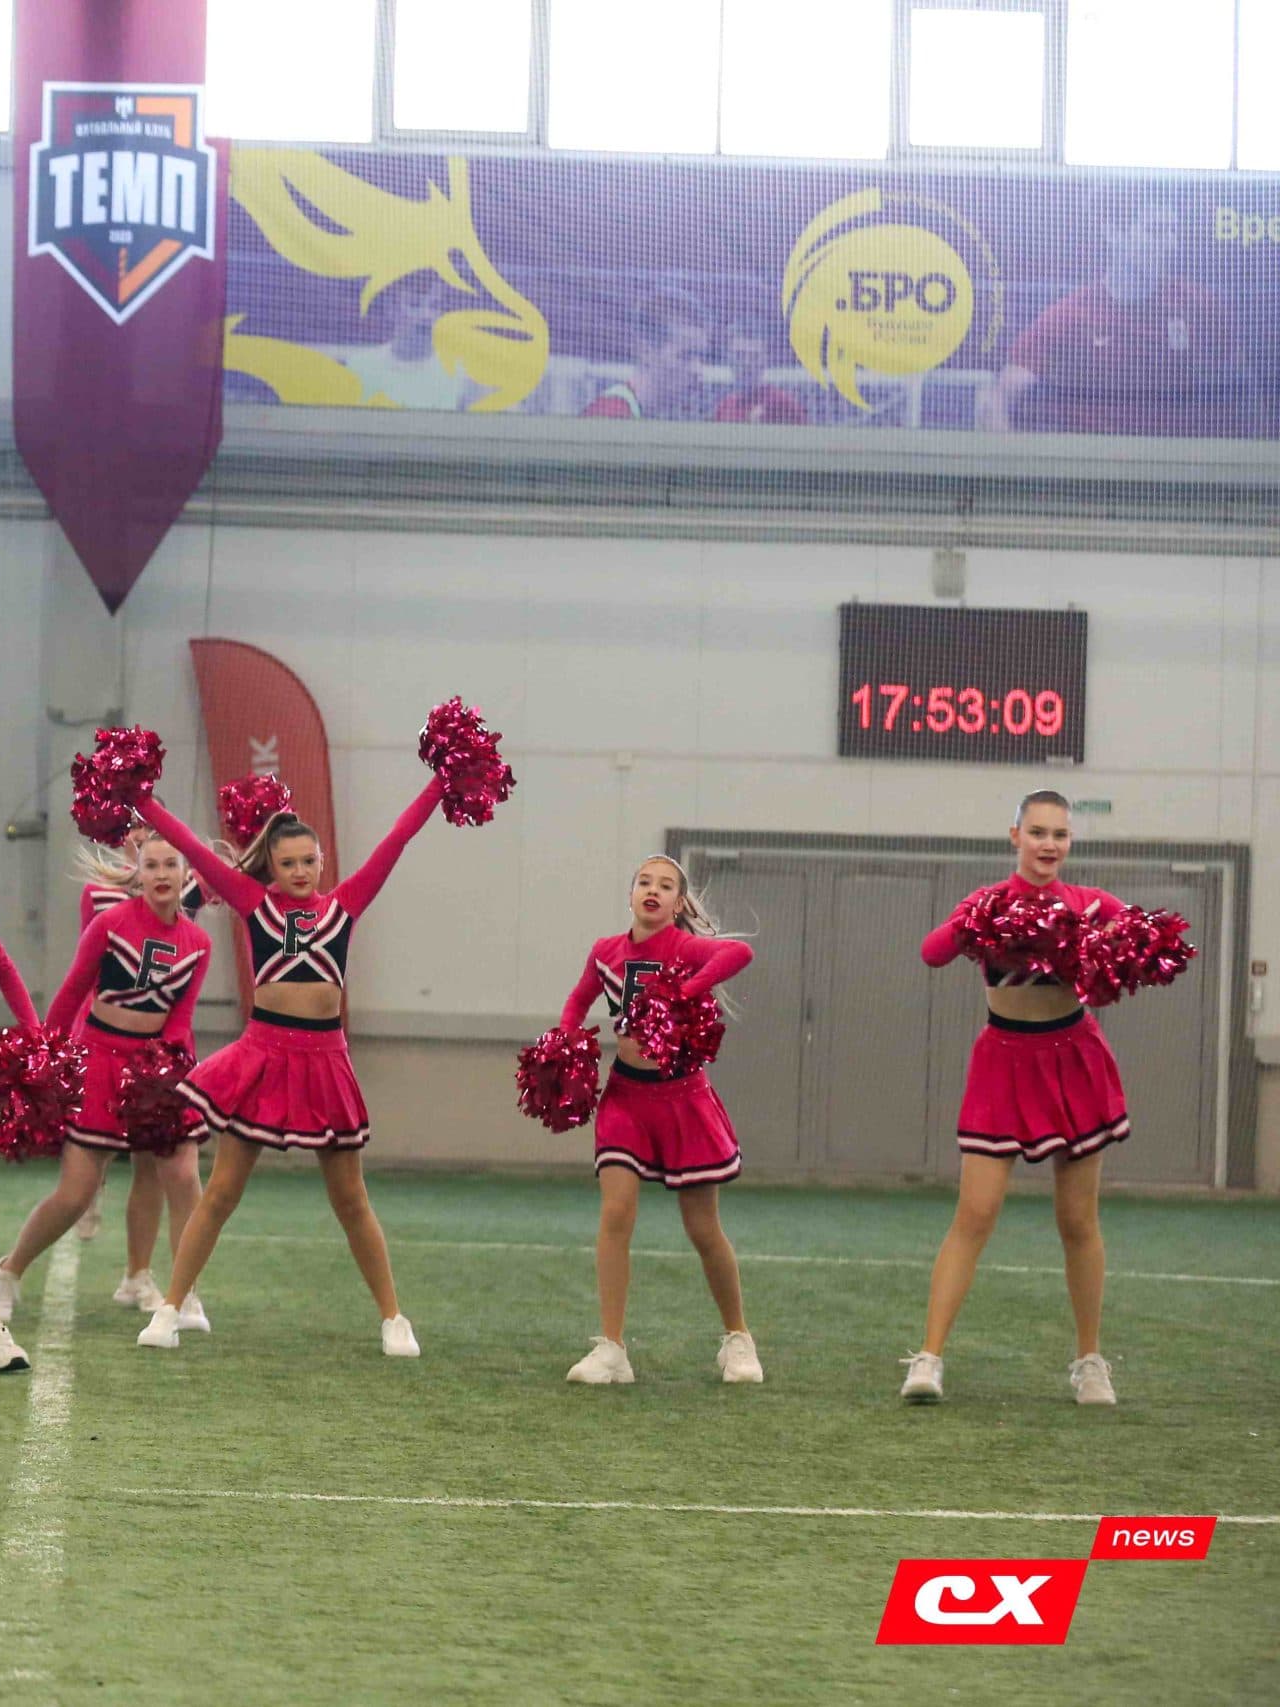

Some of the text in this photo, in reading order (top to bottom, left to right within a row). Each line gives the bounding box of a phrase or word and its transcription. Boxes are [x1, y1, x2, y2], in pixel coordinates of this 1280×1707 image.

[49, 150, 197, 233] ТЕМП
[851, 683, 1065, 736] 17:53:09
[282, 910, 319, 957] F
[134, 938, 177, 990] F
